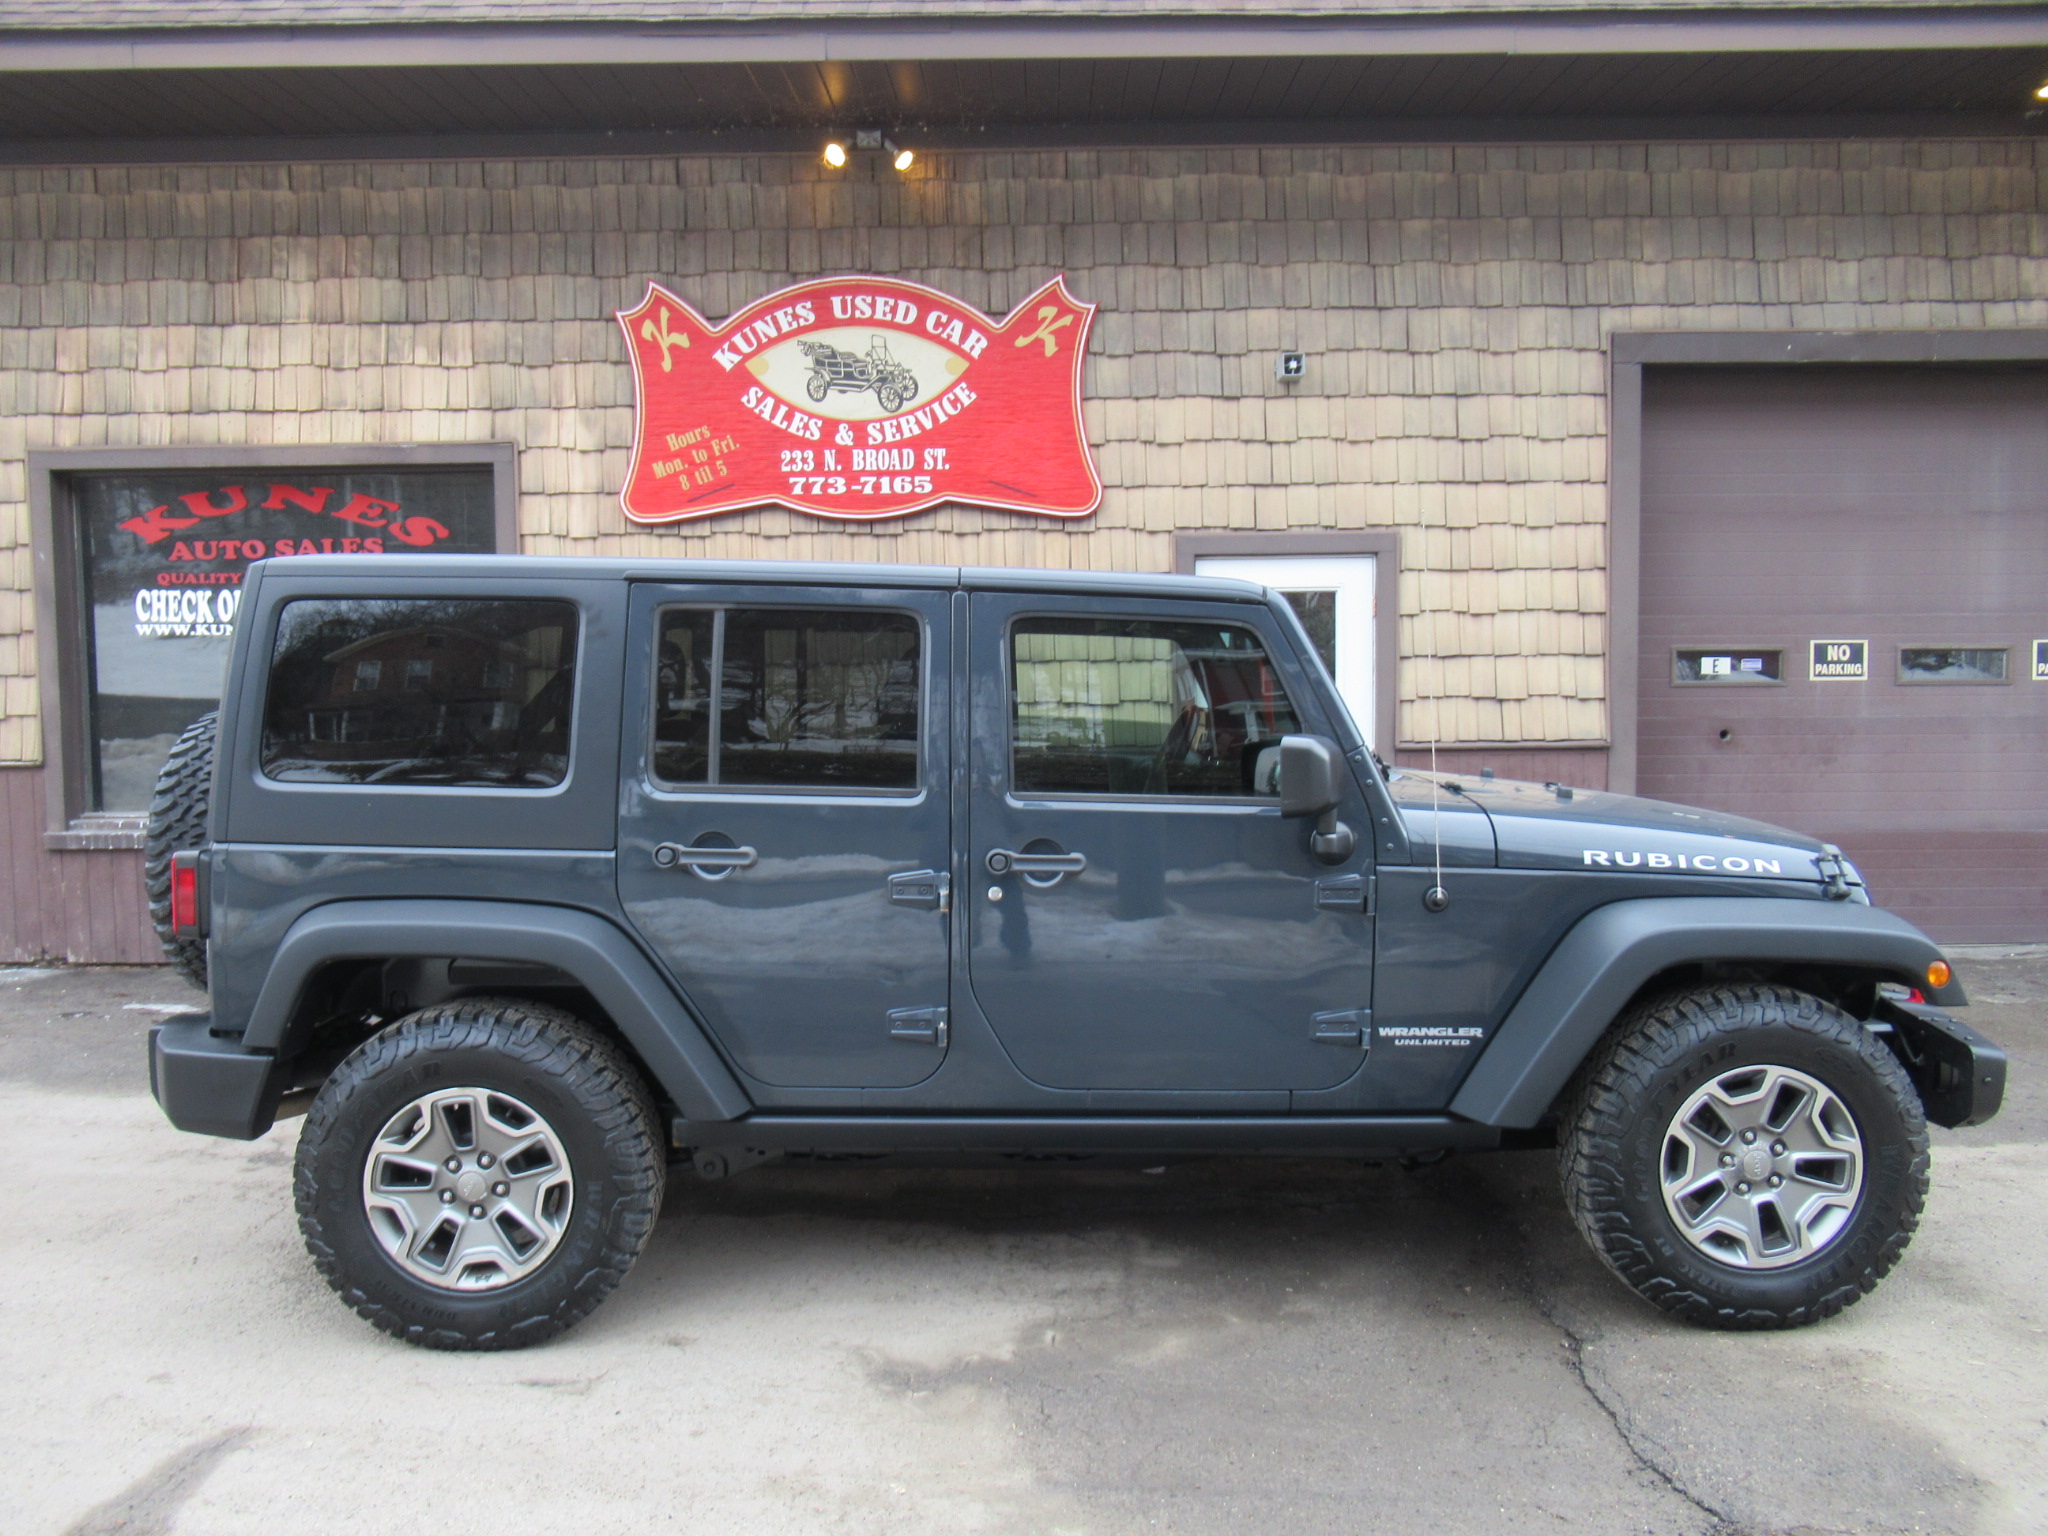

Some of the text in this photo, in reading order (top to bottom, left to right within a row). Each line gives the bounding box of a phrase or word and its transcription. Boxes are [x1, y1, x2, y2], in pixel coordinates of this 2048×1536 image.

[640, 306, 692, 374] K
[711, 294, 989, 372] KUNES USED CAR
[1014, 305, 1074, 358] K
[740, 381, 978, 446] SALES & SERVICE
[666, 425, 711, 452] Hours
[652, 434, 740, 479] Mon. to Fri.
[780, 447, 950, 472] 233 N. BROAD ST.
[679, 460, 728, 491] 8 til 5
[789, 475, 933, 495] 773-7165
[119, 483, 450, 546] KUNES
[168, 538, 384, 562] AUTO SALES
[157, 572, 243, 586] QUALITY
[135, 588, 215, 624] CHECK
[1827, 644, 1851, 661] NO
[1815, 663, 1863, 675] PARKING
[1582, 849, 1782, 875] RUBICON
[1378, 1027, 1483, 1037] WRANGLER
